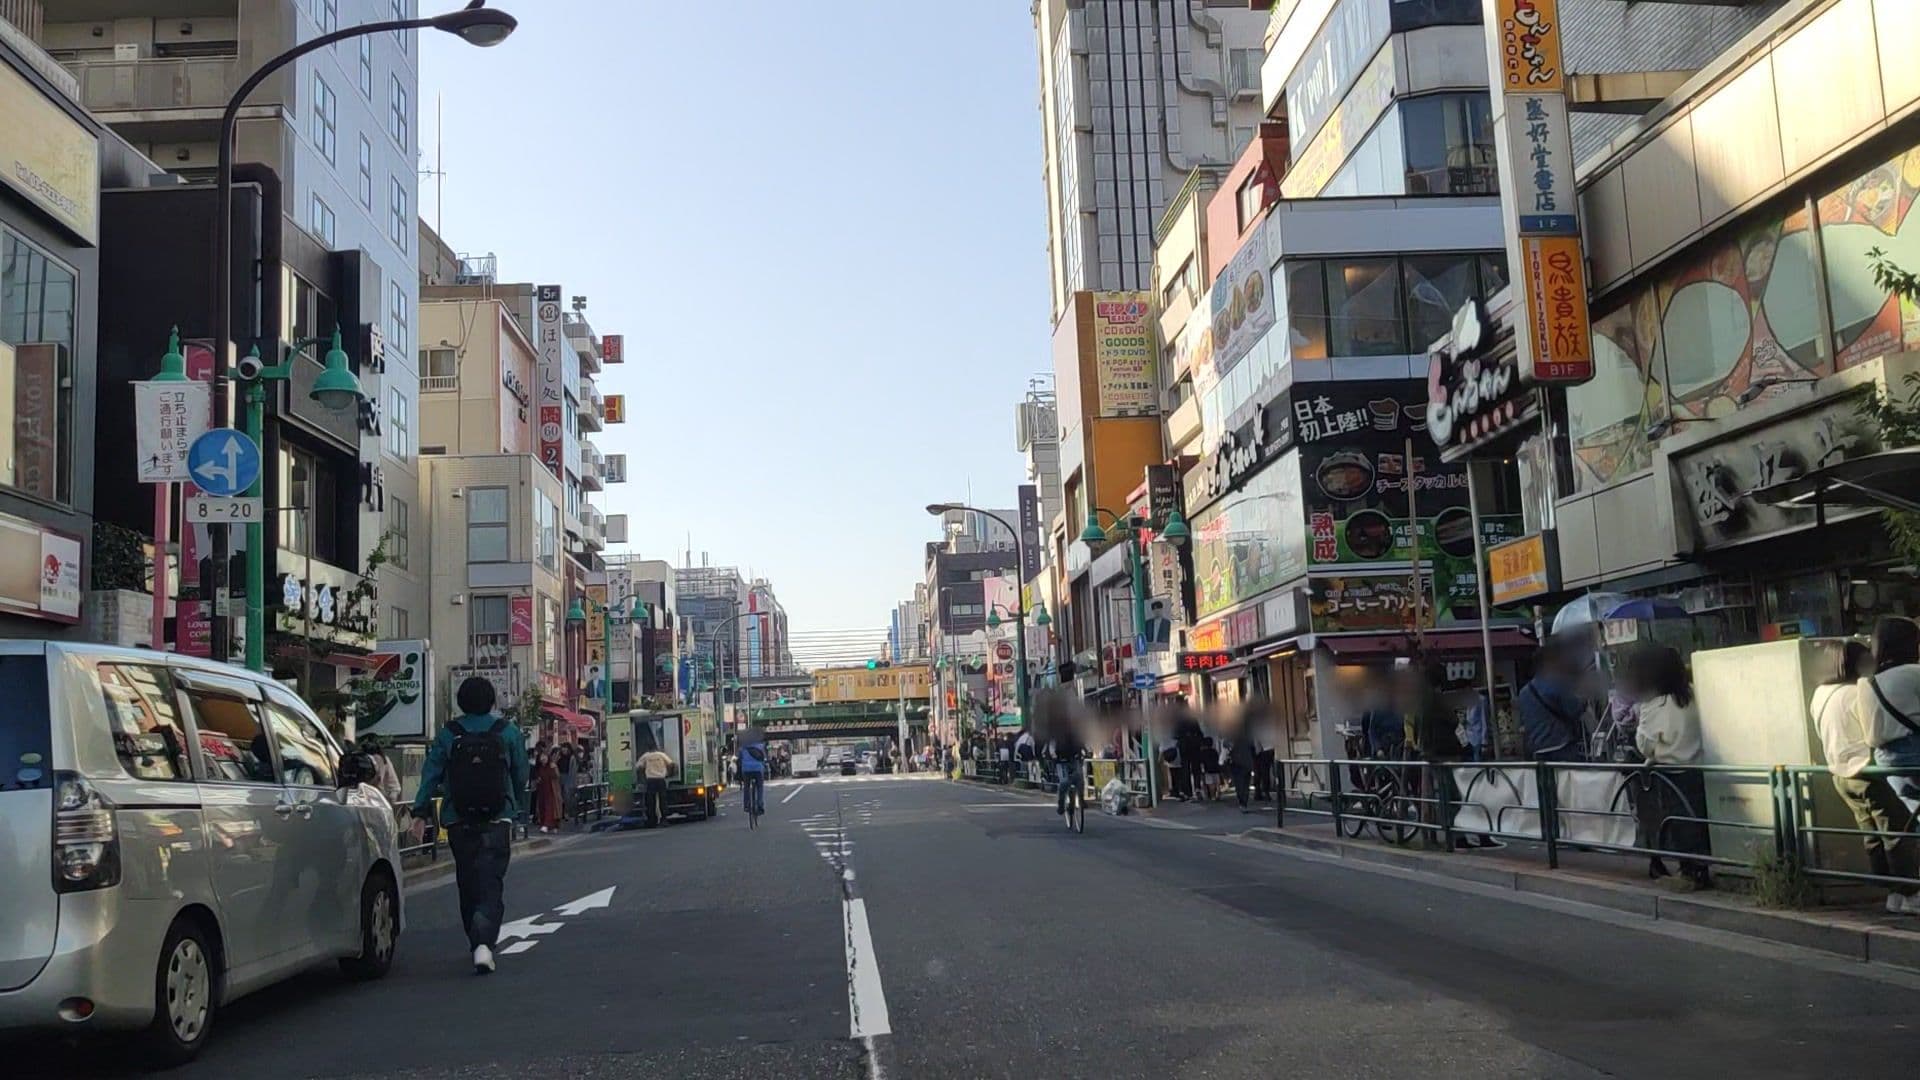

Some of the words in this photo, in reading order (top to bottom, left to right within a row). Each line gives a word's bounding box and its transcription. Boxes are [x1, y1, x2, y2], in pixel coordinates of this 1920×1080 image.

[543, 287, 556, 300] 5F
[1532, 250, 1549, 352] TORIKIZOKU
[1548, 250, 1582, 356] 鳥貴族
[543, 328, 560, 401] ほぐし処
[1105, 338, 1145, 347] GOODS
[1550, 363, 1576, 376] B1F
[174, 391, 187, 460] 立ち止まらず
[1294, 395, 1334, 421] 日本
[159, 391, 173, 475] ご通行願います
[1311, 513, 1339, 561] 熟成
[381, 681, 420, 689] HOLDINGS
